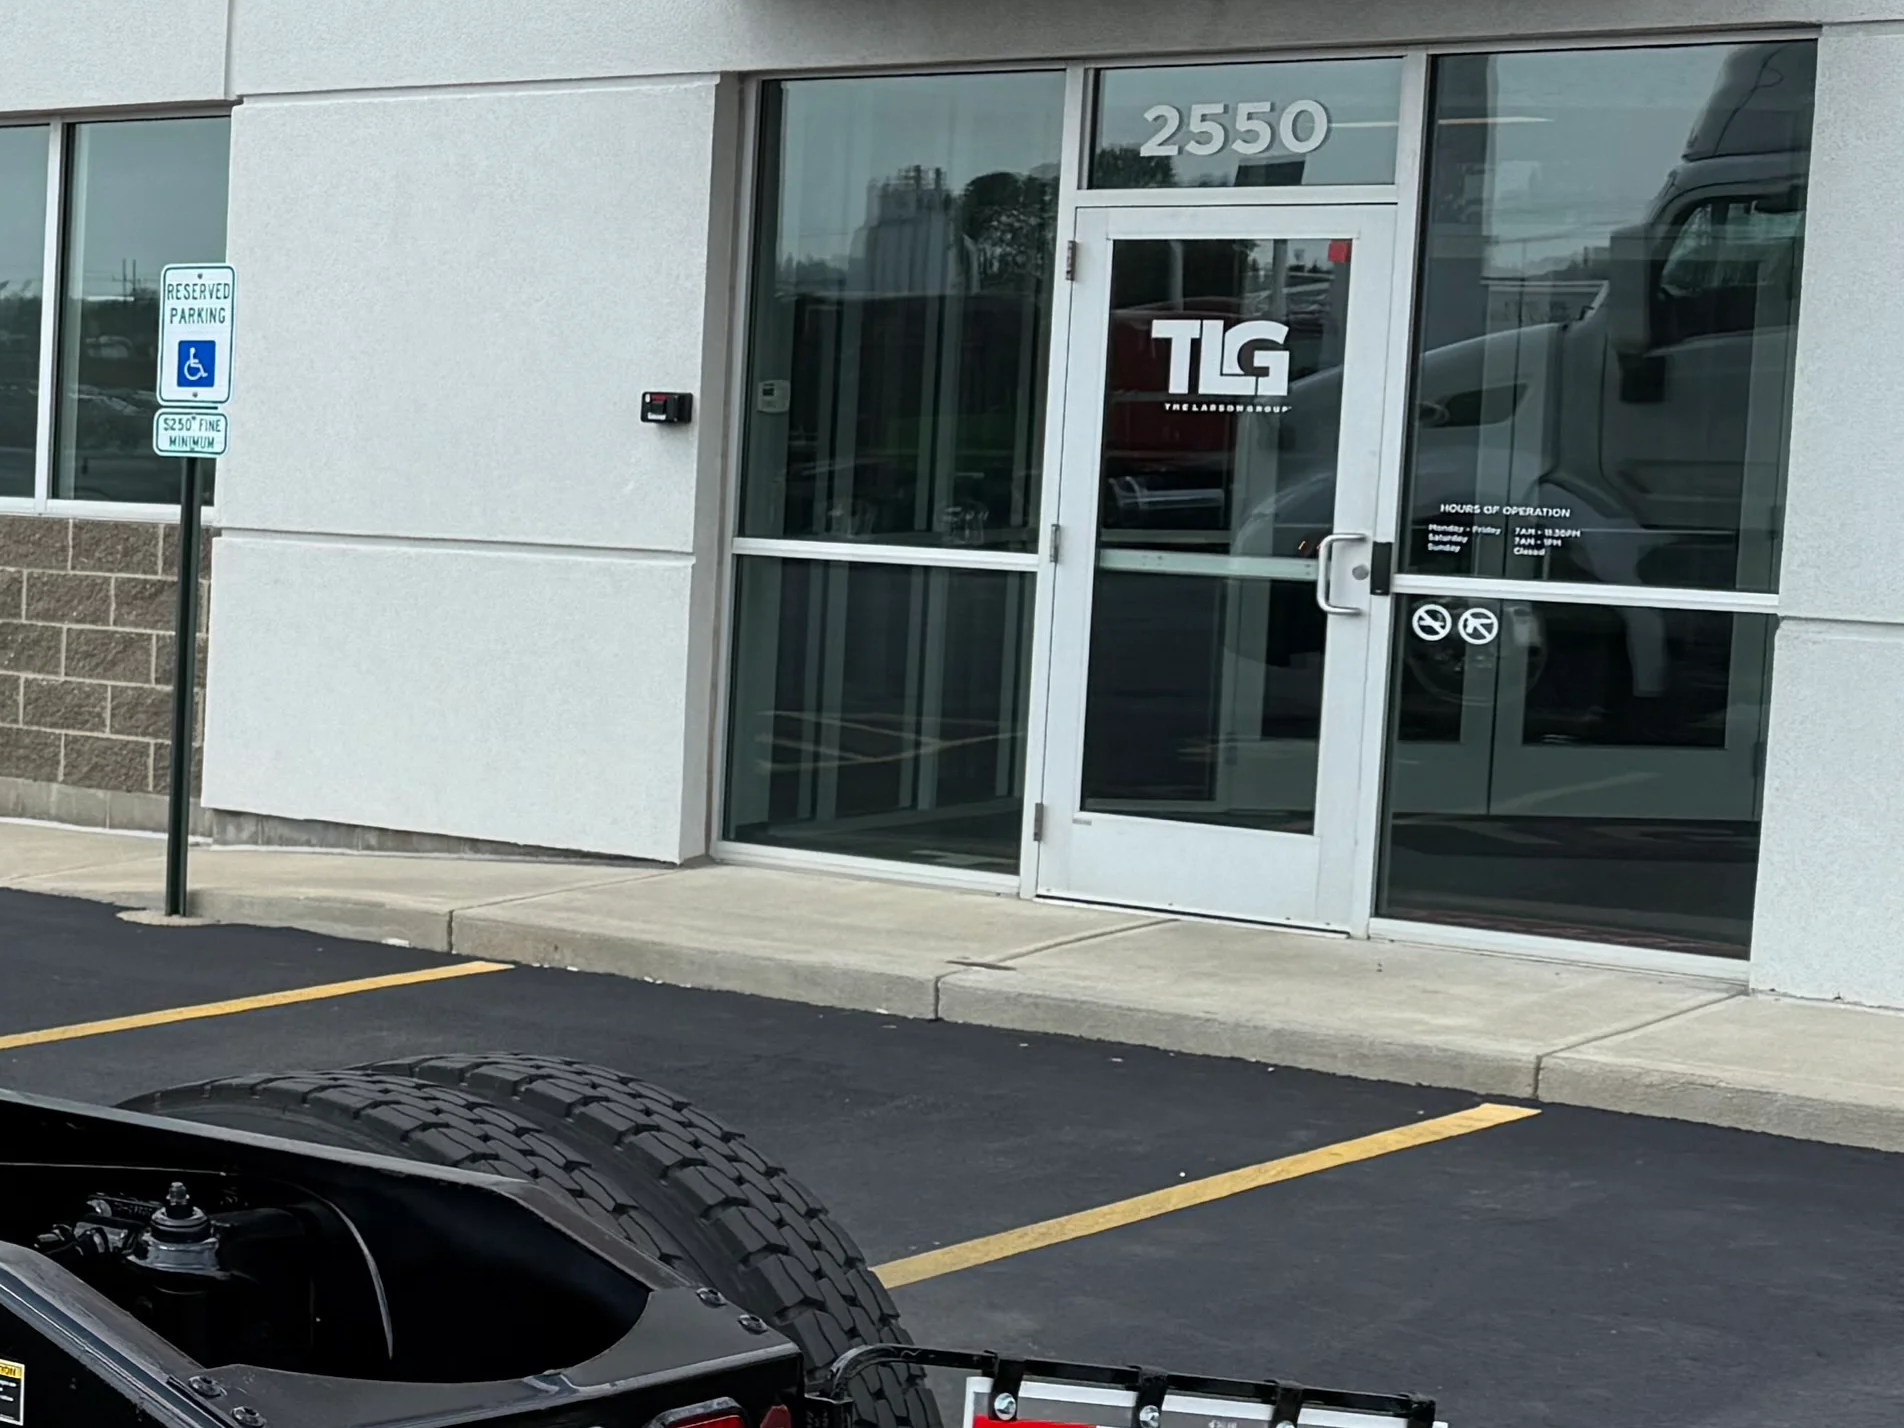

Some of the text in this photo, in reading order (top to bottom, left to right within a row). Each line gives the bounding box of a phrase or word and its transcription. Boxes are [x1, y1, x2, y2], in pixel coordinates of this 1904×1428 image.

[1140, 99, 1329, 157] 2550
[167, 283, 230, 301] RESERVED
[169, 307, 226, 324] PARKING
[1151, 319, 1290, 396] TLG
[1165, 403, 1188, 411] THE
[163, 417, 221, 432] $250 FINE
[169, 436, 215, 449] MINIMUM
[1440, 503, 1571, 518] HOURS OF OPERATION
[1428, 524, 1464, 534] Monday
[1472, 525, 1501, 535] Friday
[1428, 533, 1468, 543] Saturday
[1428, 543, 1546, 556] Sunday Closed
